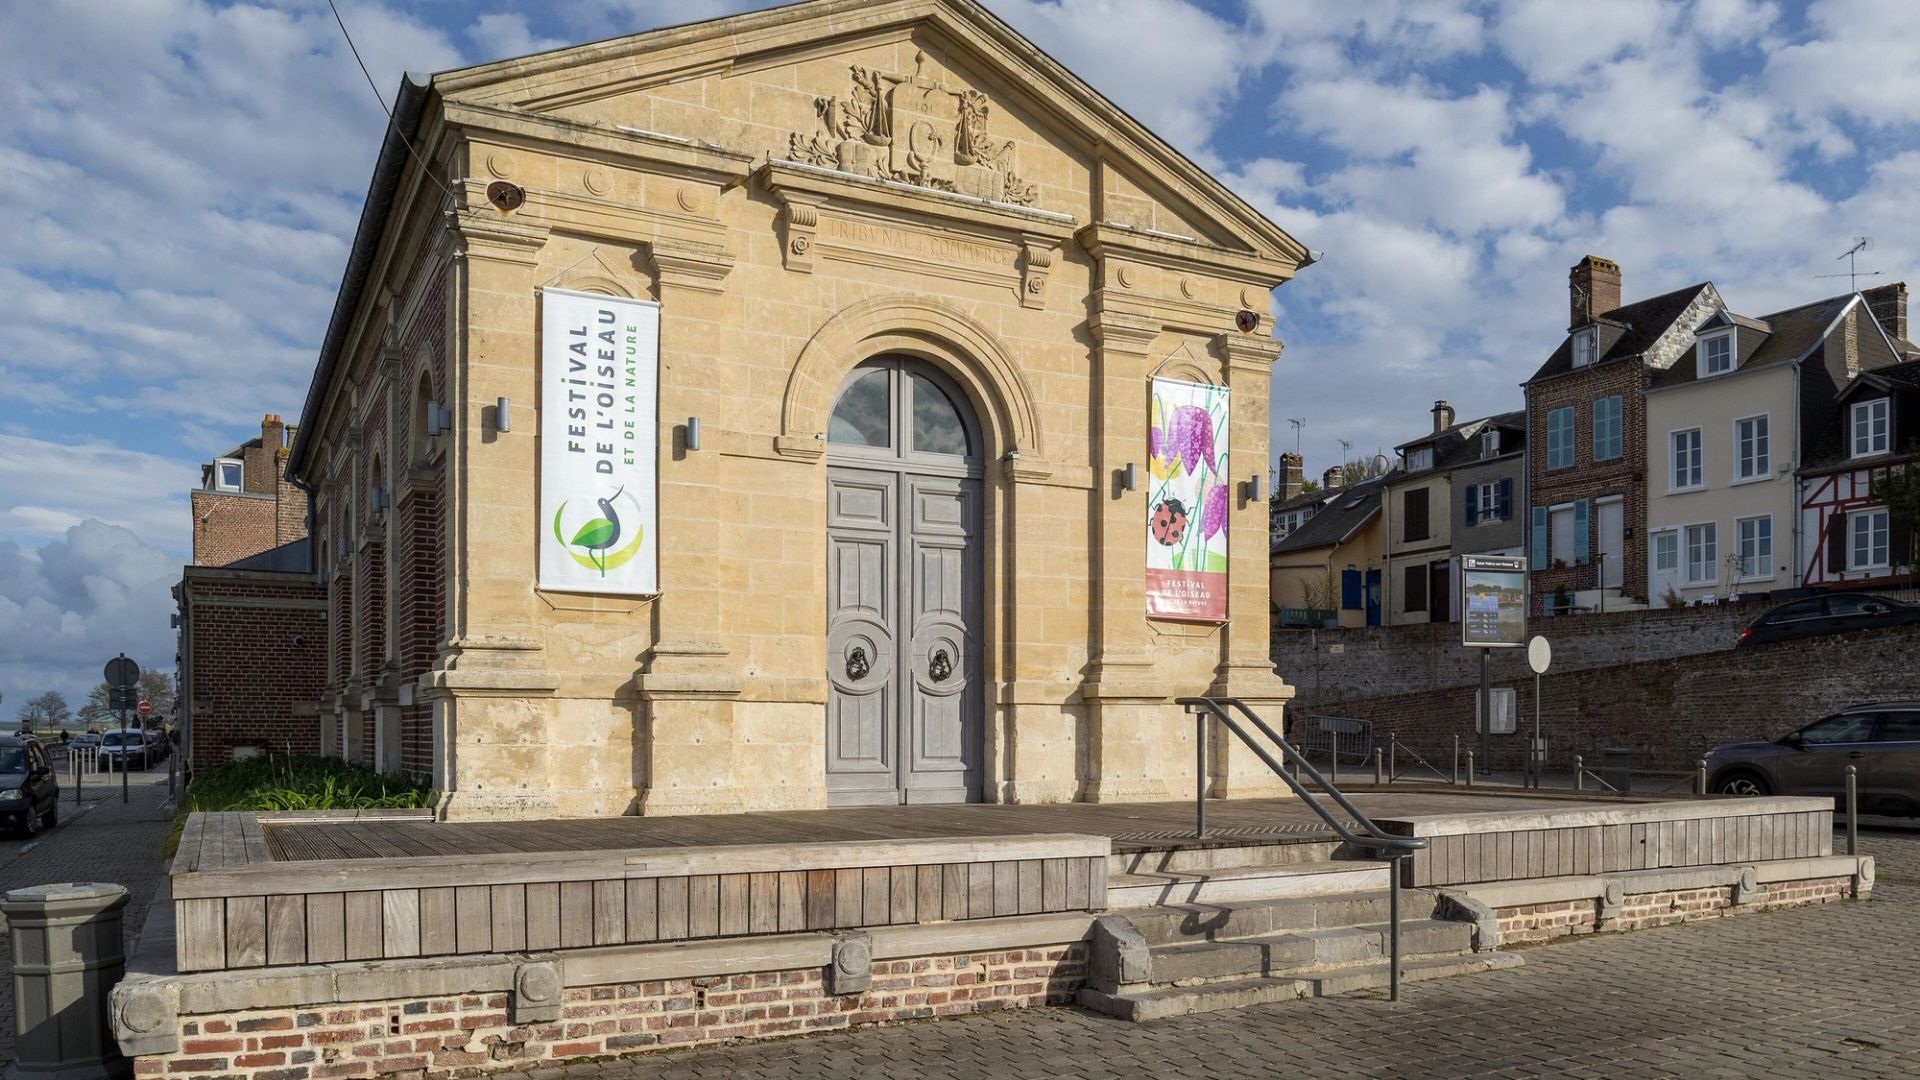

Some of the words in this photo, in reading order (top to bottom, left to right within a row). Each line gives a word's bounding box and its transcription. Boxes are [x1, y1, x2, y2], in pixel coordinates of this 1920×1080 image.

[625, 325, 637, 387] NATURE
[625, 395, 635, 413] LA
[624, 421, 635, 440] DE
[596, 442, 613, 475] DE
[624, 447, 635, 465] ET
